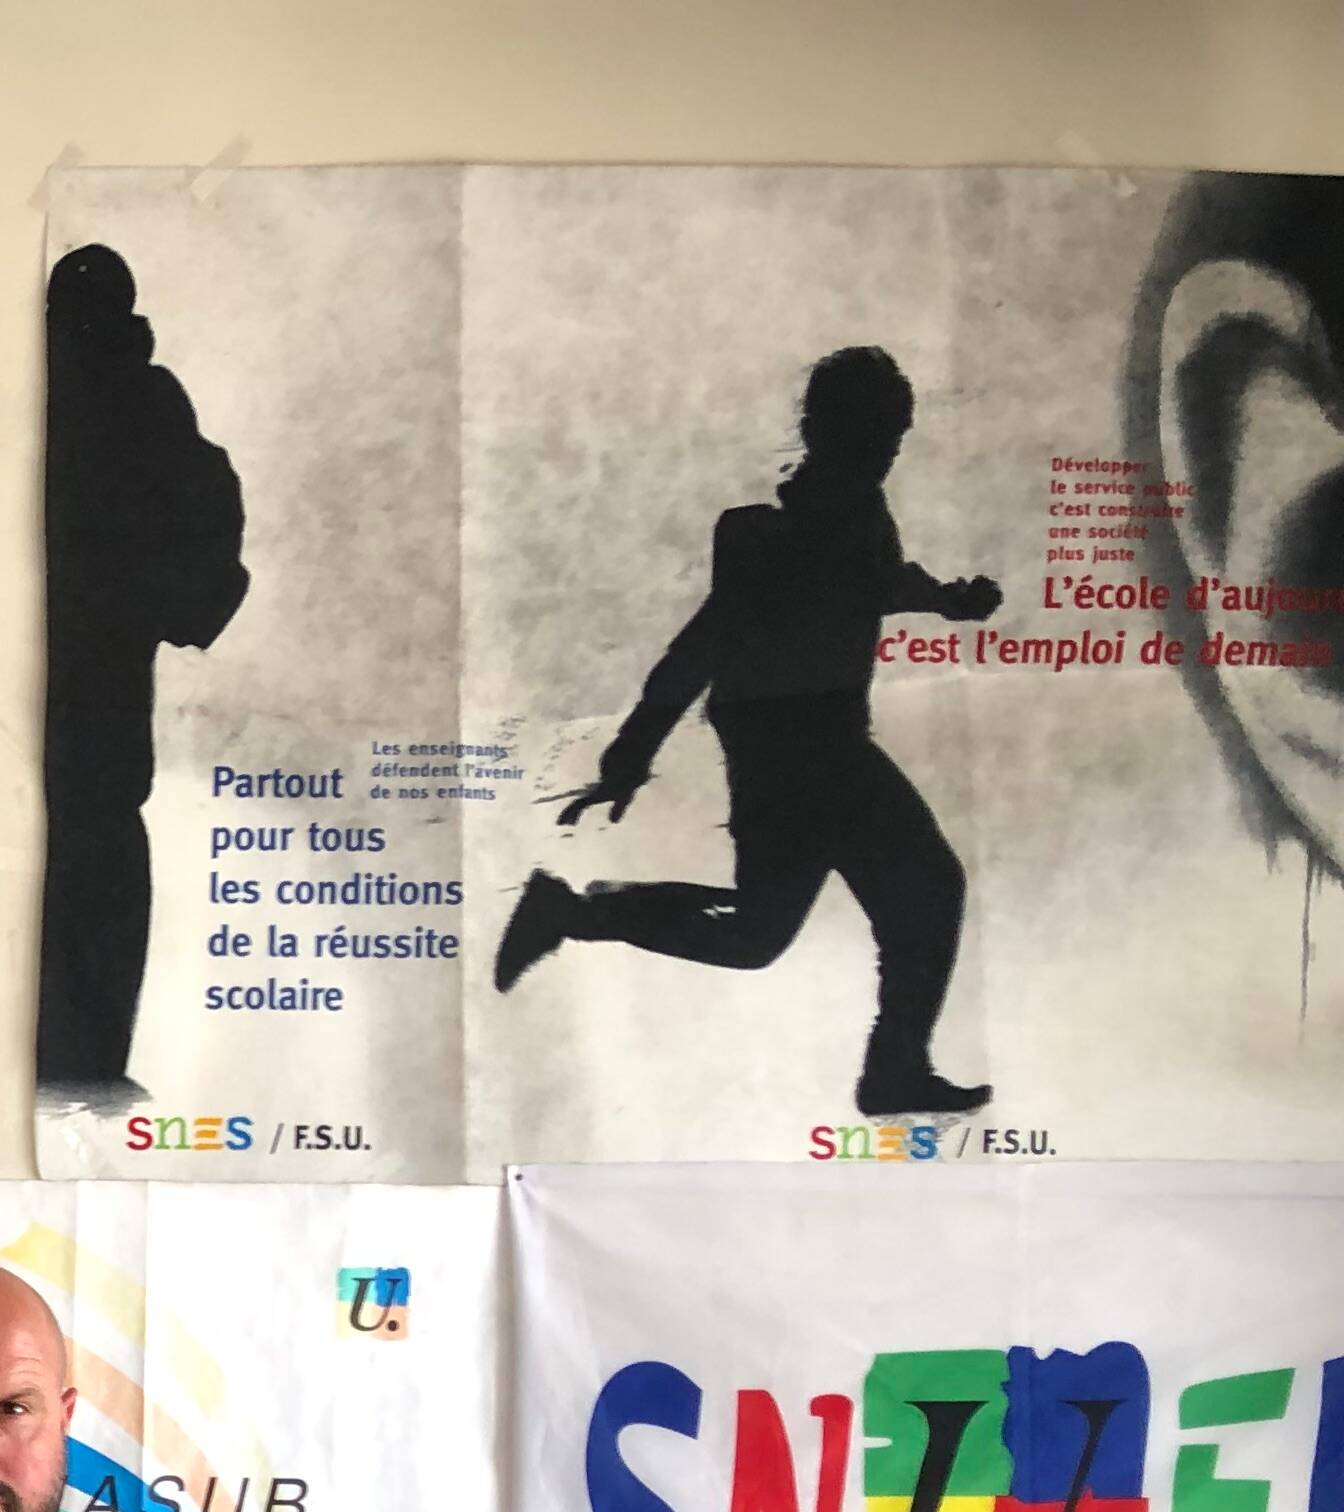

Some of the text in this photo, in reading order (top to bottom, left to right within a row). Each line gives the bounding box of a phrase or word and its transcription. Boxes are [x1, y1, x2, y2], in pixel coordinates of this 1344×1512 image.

[1049, 480, 1066, 495] le
[1075, 480, 1135, 496] service
[1049, 502, 1091, 517] c'est
[1049, 526, 1080, 539] une
[1046, 547, 1135, 564] plus juste
[1044, 575, 1170, 610] L'école
[877, 630, 1334, 672] c'est l'emploi de demain
[372, 741, 509, 758] Les enseignants
[212, 766, 344, 798] Partout
[369, 764, 525, 780] défendent l'avenir
[369, 786, 496, 801] de nos enfants
[211, 822, 386, 858] pour tous
[209, 872, 464, 905] les conditions
[208, 924, 459, 959] de la réussite
[205, 977, 344, 1011] scolaire
[295, 1125, 371, 1151] F.S.U.
[983, 1128, 1056, 1156] F.S.U.
